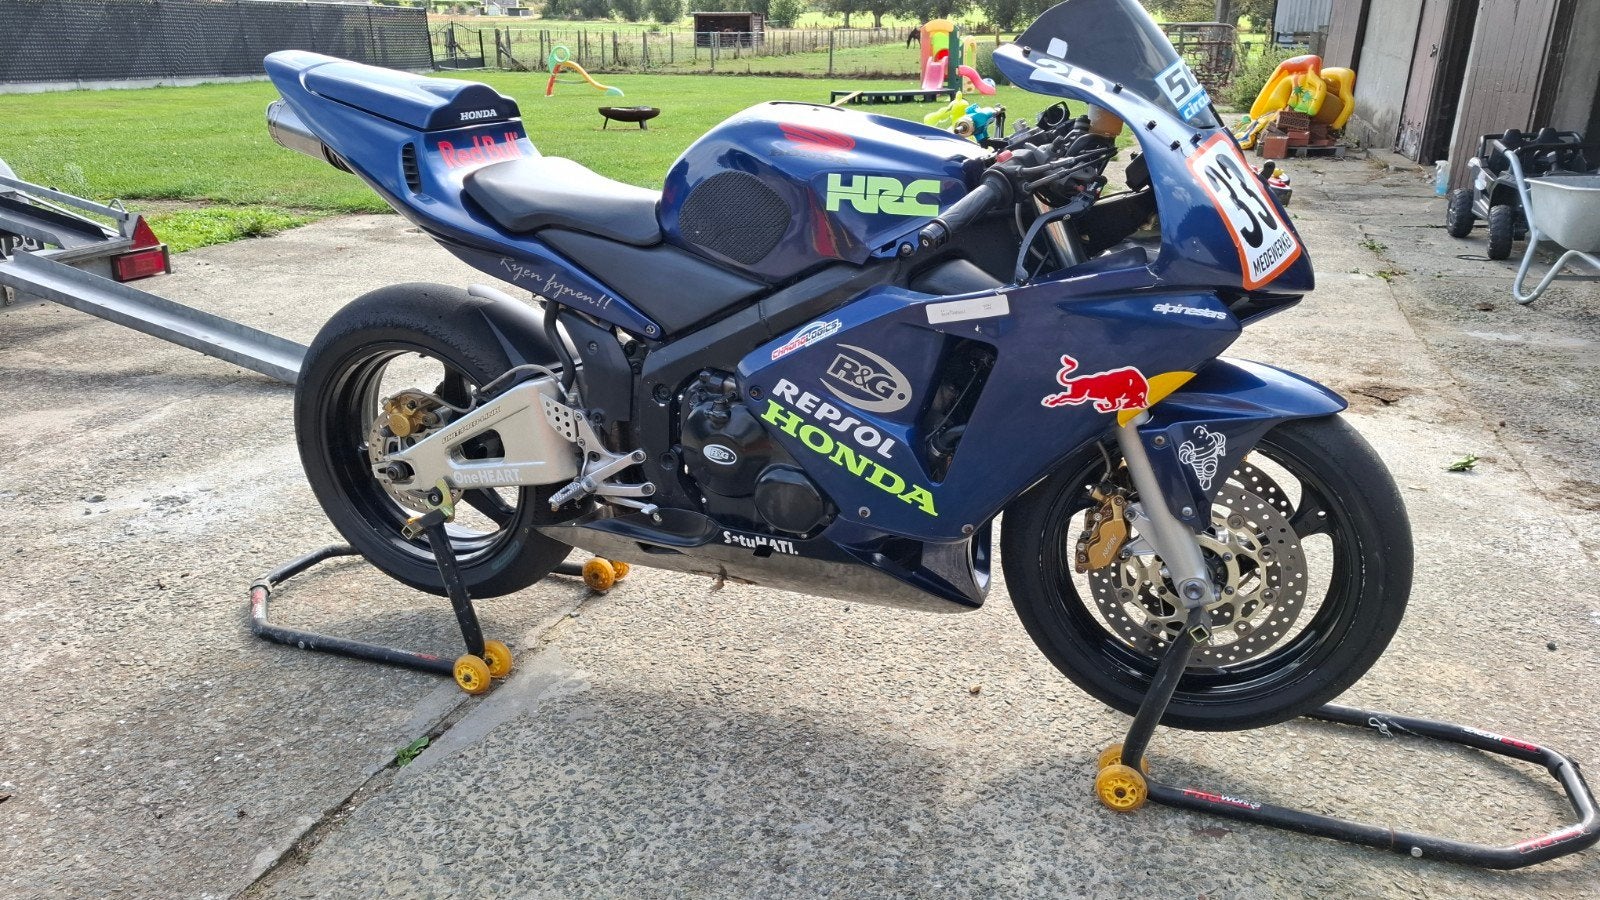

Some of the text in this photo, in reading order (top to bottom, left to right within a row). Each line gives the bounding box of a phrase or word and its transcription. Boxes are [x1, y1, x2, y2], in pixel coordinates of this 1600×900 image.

[460, 109, 498, 120] HONDA
[437, 132, 521, 169] Red Bull
[826, 173, 940, 217] HRC
[1204, 153, 1278, 248] 33
[1153, 303, 1227, 320] alpinestars
[827, 353, 899, 400] R&G
[772, 378, 896, 459] REPSOL
[709, 447, 730, 460] R&G
[761, 399, 938, 517] HONDA
